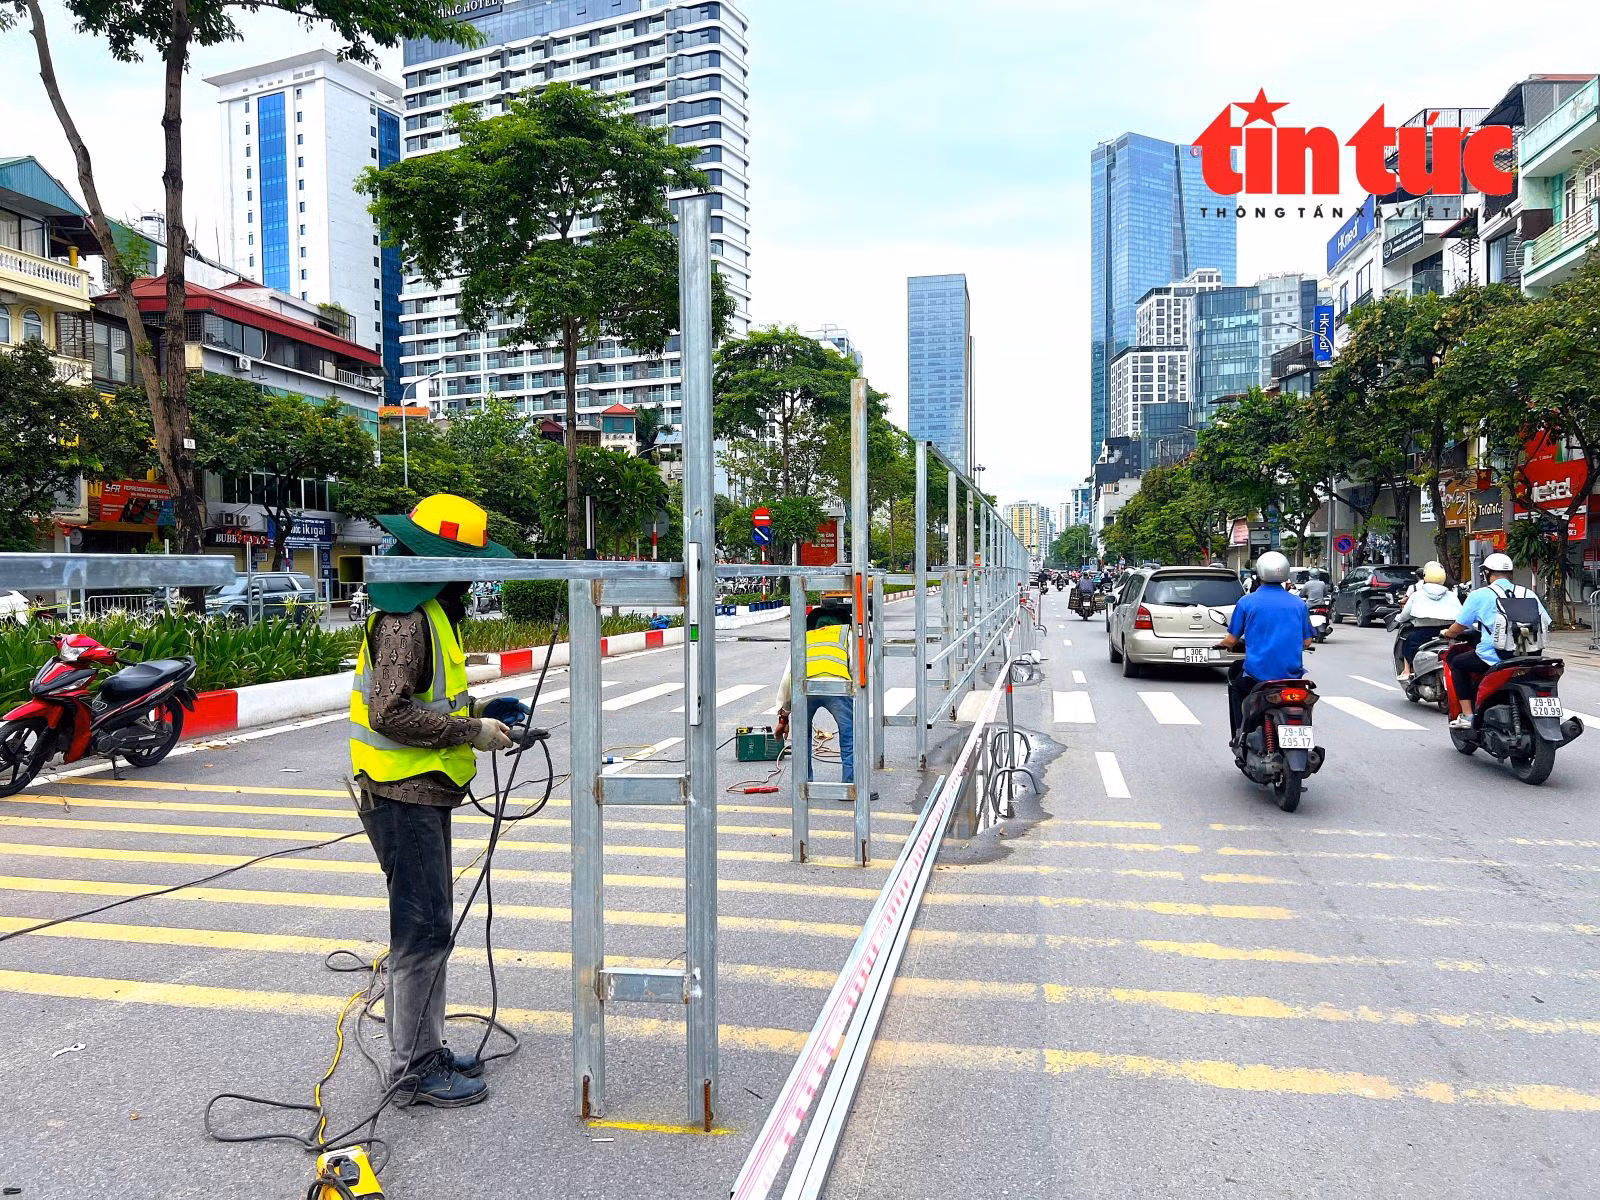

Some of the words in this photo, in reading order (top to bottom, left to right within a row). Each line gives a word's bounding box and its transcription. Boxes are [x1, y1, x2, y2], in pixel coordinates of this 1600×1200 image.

[1531, 477, 1573, 503] iettel
[1190, 648, 1203, 656] 30E
[1533, 706, 1561, 716] 520.99
[1281, 737, 1311, 747] 295.17
